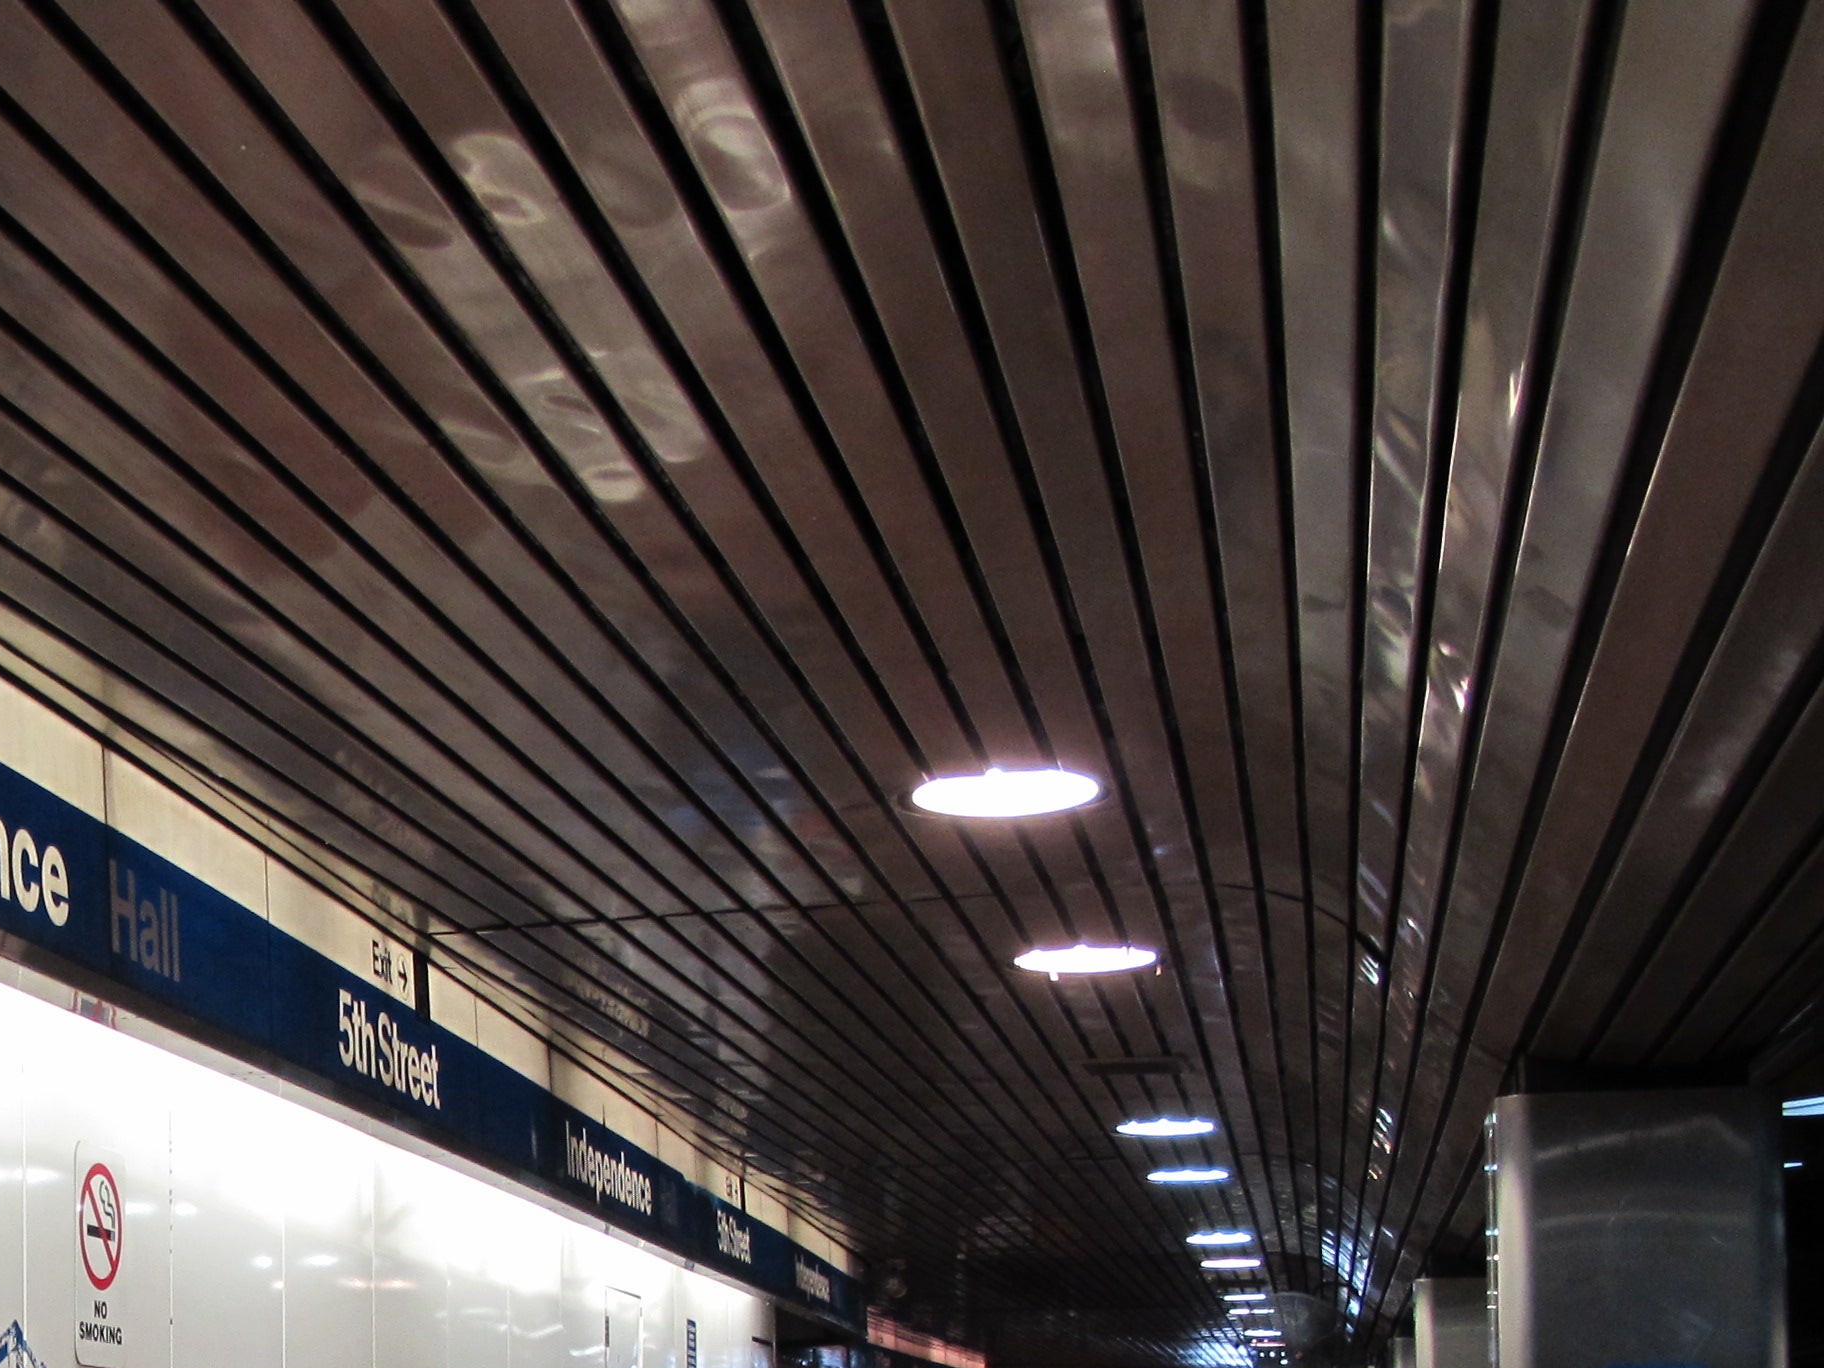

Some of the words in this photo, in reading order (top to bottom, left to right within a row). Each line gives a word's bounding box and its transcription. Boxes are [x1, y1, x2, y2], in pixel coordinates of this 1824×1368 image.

[108, 858, 181, 982] Hall
[372, 939, 393, 985] Exit
[338, 988, 376, 1080] 5th
[377, 1011, 441, 1110] Street
[565, 1120, 653, 1216] Independence
[79, 1321, 123, 1346] SMOKING
[93, 1300, 108, 1320] NO
